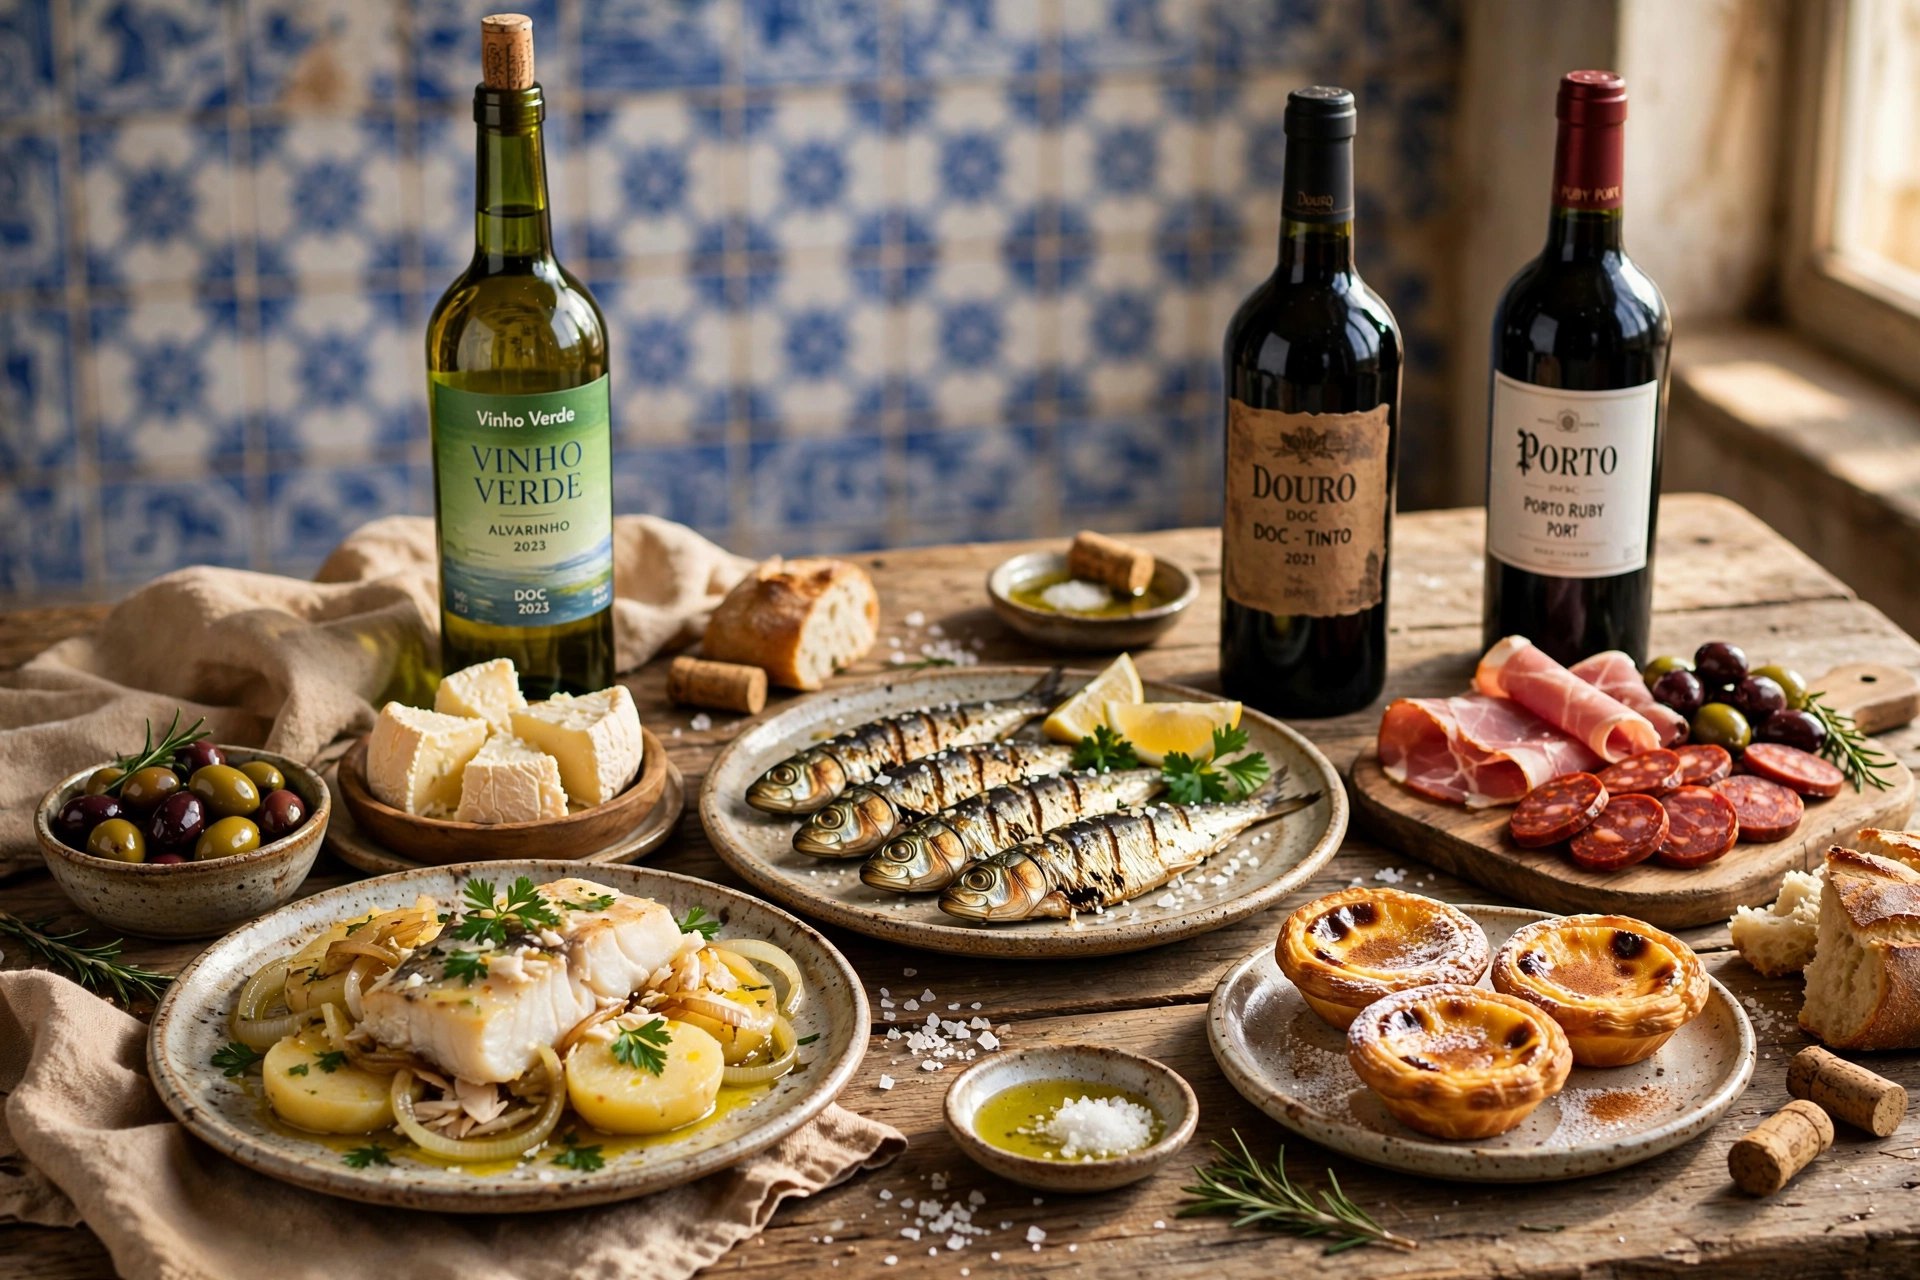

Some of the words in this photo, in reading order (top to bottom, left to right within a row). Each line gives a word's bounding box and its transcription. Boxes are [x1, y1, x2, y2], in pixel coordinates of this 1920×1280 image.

[476, 410, 525, 428] Vinho
[529, 406, 575, 426] Verde
[472, 441, 582, 474] VINHO
[1516, 428, 1618, 477] PORTO
[474, 472, 583, 506] VERDE
[1252, 464, 1356, 504] DOURO
[1286, 509, 1318, 522] DOC
[1524, 497, 1564, 517] PORTO
[1568, 503, 1605, 518] RUBY
[488, 521, 570, 536] ALVARINHO
[1254, 524, 1288, 544] DOC
[1305, 528, 1352, 546] TINTO
[1547, 522, 1579, 538] PORT
[514, 541, 546, 551] 2023
[1285, 553, 1316, 565] 2021
[514, 589, 547, 602] DOC
[518, 602, 549, 614] 2023
